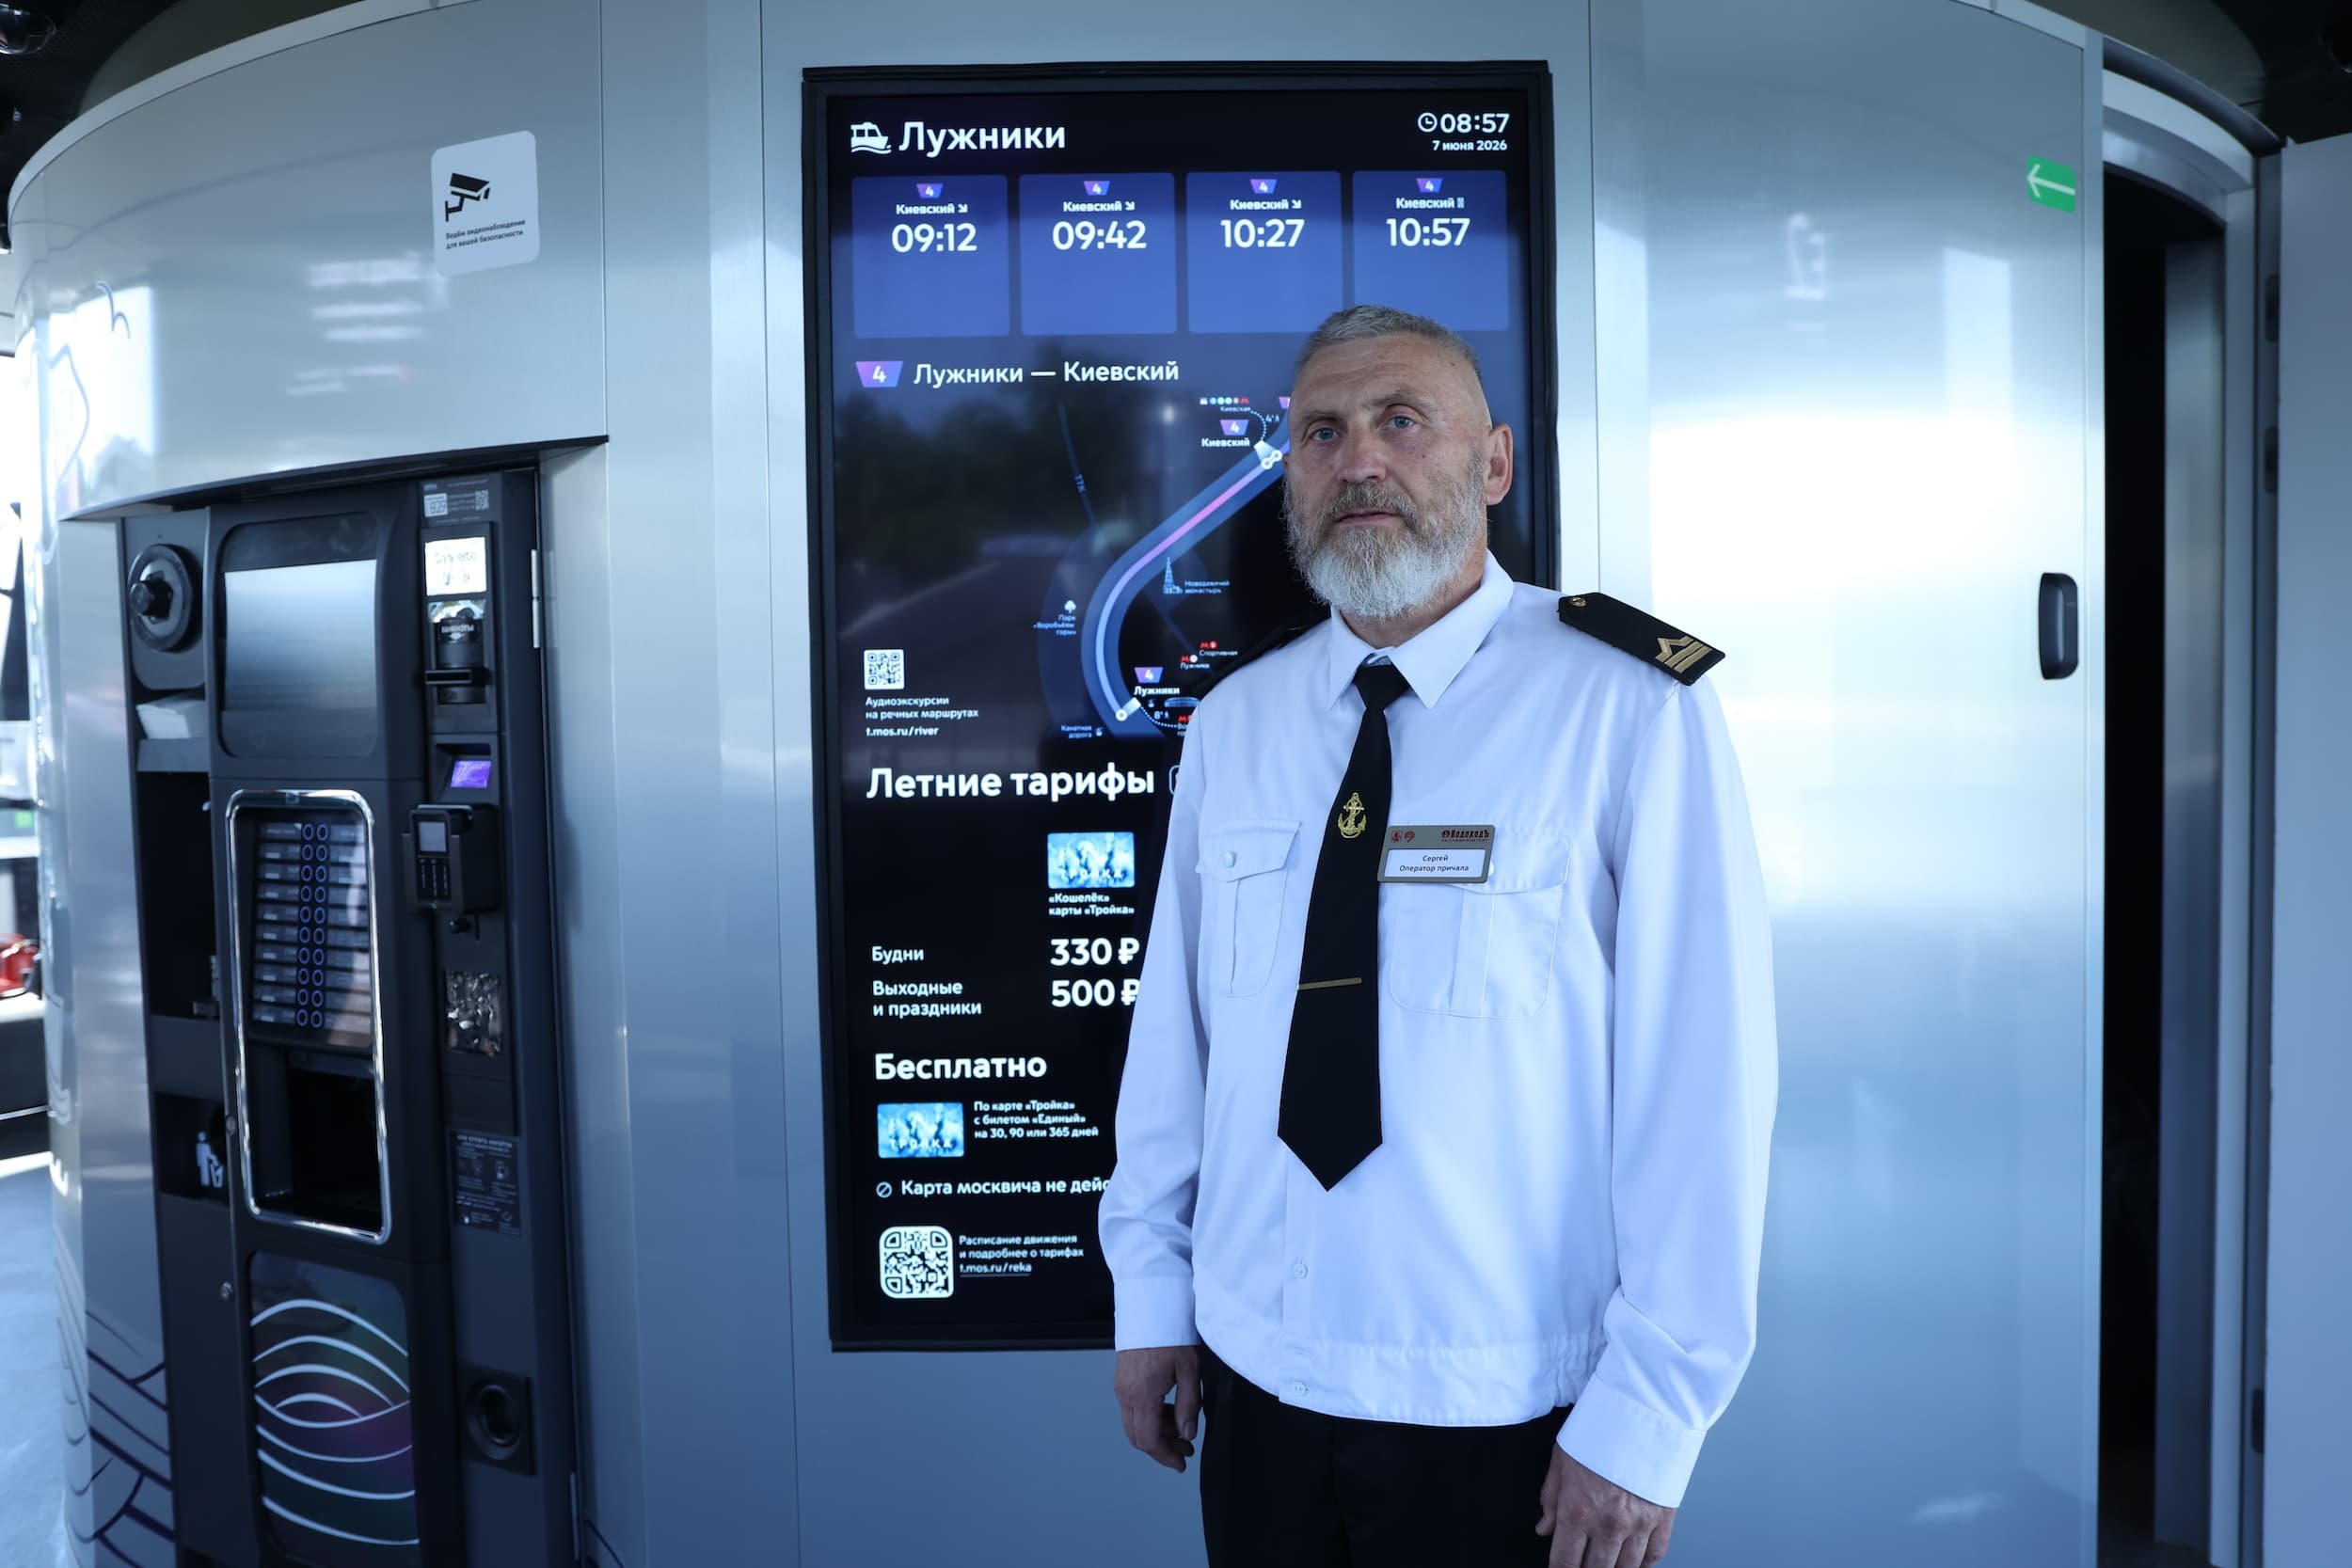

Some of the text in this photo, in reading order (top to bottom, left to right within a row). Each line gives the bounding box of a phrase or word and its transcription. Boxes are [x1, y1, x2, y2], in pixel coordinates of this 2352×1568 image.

[1439, 112, 1510, 135] 08:57
[898, 119, 1067, 157] Лужники
[1432, 139, 1508, 151] 7 июня 2026
[924, 184, 934, 198] 4
[1091, 182, 1102, 195] 4
[1259, 181, 1269, 194] 4
[1424, 179, 1435, 192] 4
[896, 200, 955, 215] Киевский
[1063, 198, 1122, 214] Киевский
[1230, 198, 1289, 212] Киевский
[1395, 196, 1455, 210] Киевский
[459, 237, 479, 247] вашей
[480, 230, 524, 244] безопасности
[891, 223, 977, 252] 09:12
[1052, 221, 1147, 250] 09:42
[1220, 219, 1305, 248] 10:27
[1387, 217, 1470, 246] 10:57
[872, 366, 886, 384] 4
[914, 363, 1024, 389] Лужники
[1063, 360, 1180, 383] Киевский
[1231, 421, 1240, 434] 4
[1201, 437, 1251, 448] Киевский
[1058, 614, 1076, 623] Парк
[1199, 649, 1238, 657] Спортивная
[1180, 662, 1210, 671] Лужники
[1144, 669, 1154, 681] 4
[1133, 686, 1181, 696] Лужники
[866, 696, 949, 708] Аудиоэкскурсии
[866, 708, 979, 721] на речных маршрутах
[866, 726, 939, 736] t.mos.ru/river
[1061, 724, 1092, 733] Канатная
[1068, 731, 1092, 739] дорога
[866, 762, 1155, 802] Летние тарифы
[1399, 864, 1436, 873] Оператор
[1048, 893, 1110, 906] «Кошелёк»
[1048, 904, 1135, 917] карты «Тройка»
[871, 946, 924, 965] Будни
[1050, 938, 1113, 966] 330
[872, 981, 963, 997] Выходные
[1051, 979, 1115, 1007] 500
[873, 1001, 982, 1019] и праздники
[874, 1053, 1047, 1081] Бесплатно
[974, 1100, 1075, 1113] По карте «Тройка»
[974, 1113, 1086, 1125] с билетом «Единый»
[975, 1126, 1099, 1140] на 30, 90 или 365 дней
[901, 1177, 1109, 1198] Карта москвича не дейс
[959, 1233, 1077, 1246] Расписание движения
[960, 1246, 1084, 1260] и подробнее о тарифах
[960, 1262, 1032, 1275] t.mos.ru/reka
